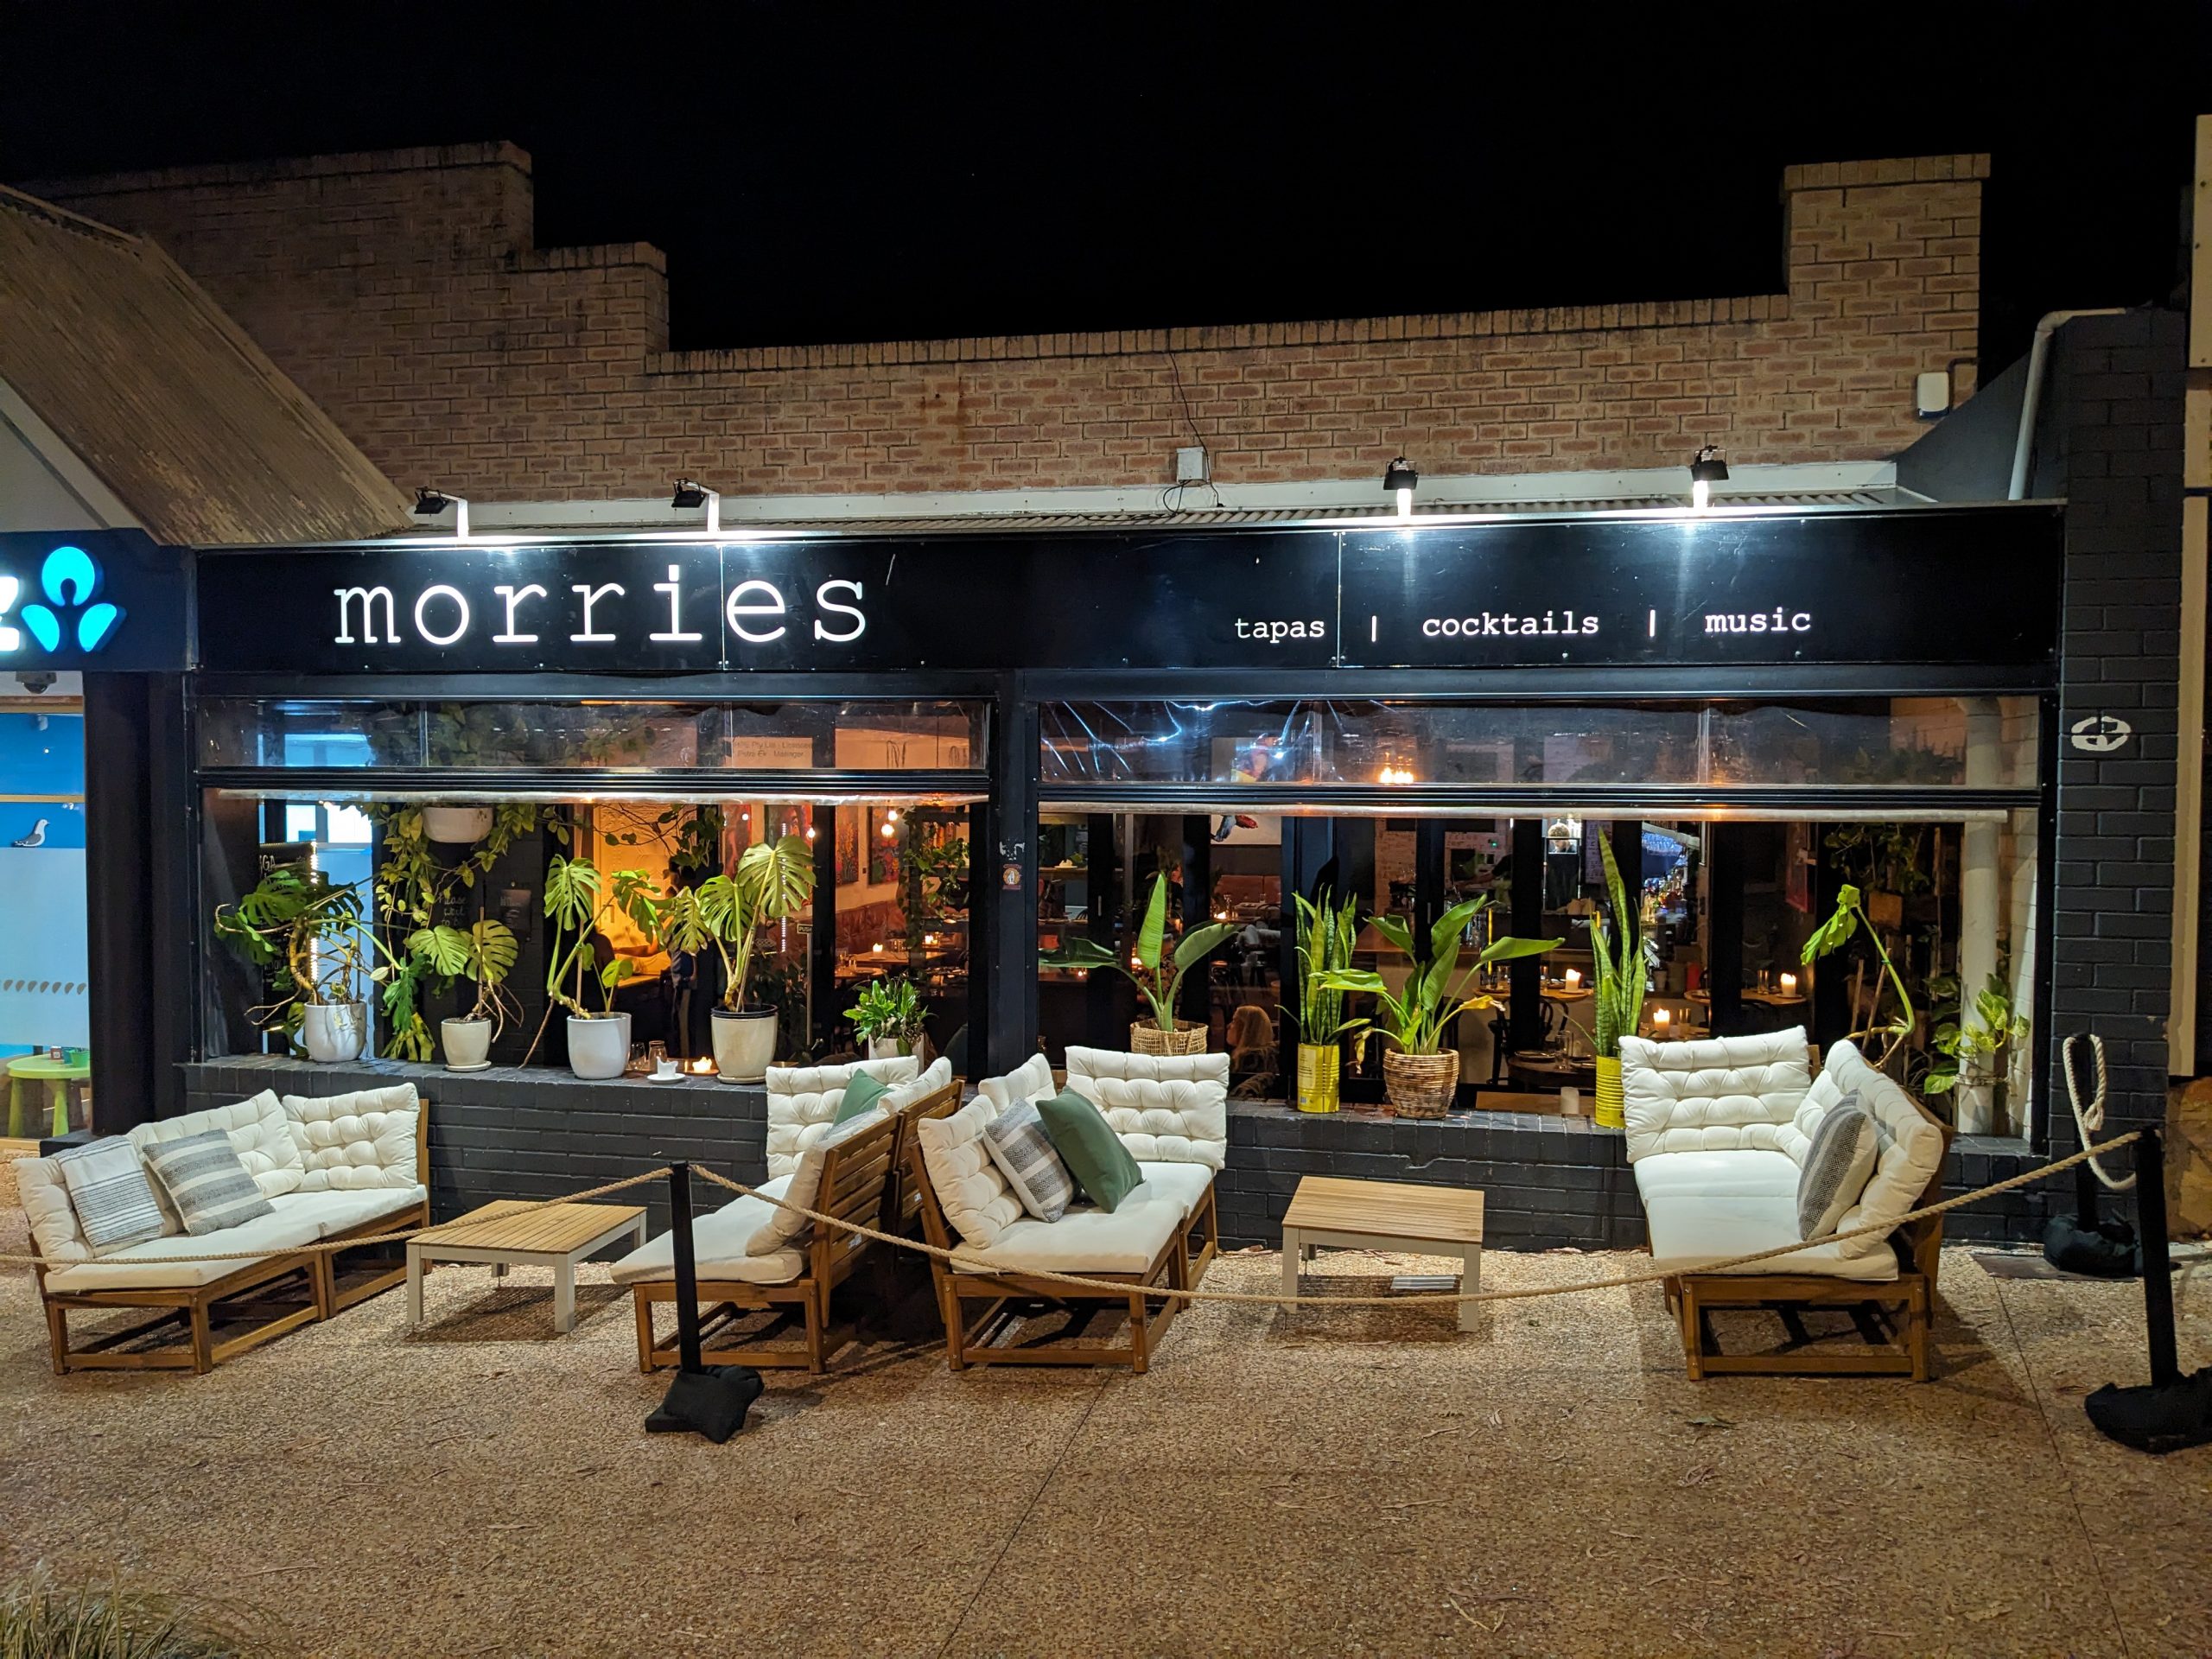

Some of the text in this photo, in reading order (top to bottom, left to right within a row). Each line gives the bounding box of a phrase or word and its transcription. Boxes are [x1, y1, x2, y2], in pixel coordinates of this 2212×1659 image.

[334, 563, 867, 645] morries
[1234, 616, 1325, 644] tapas
[1422, 609, 1600, 638] cocktails
[1704, 607, 1812, 634] music
